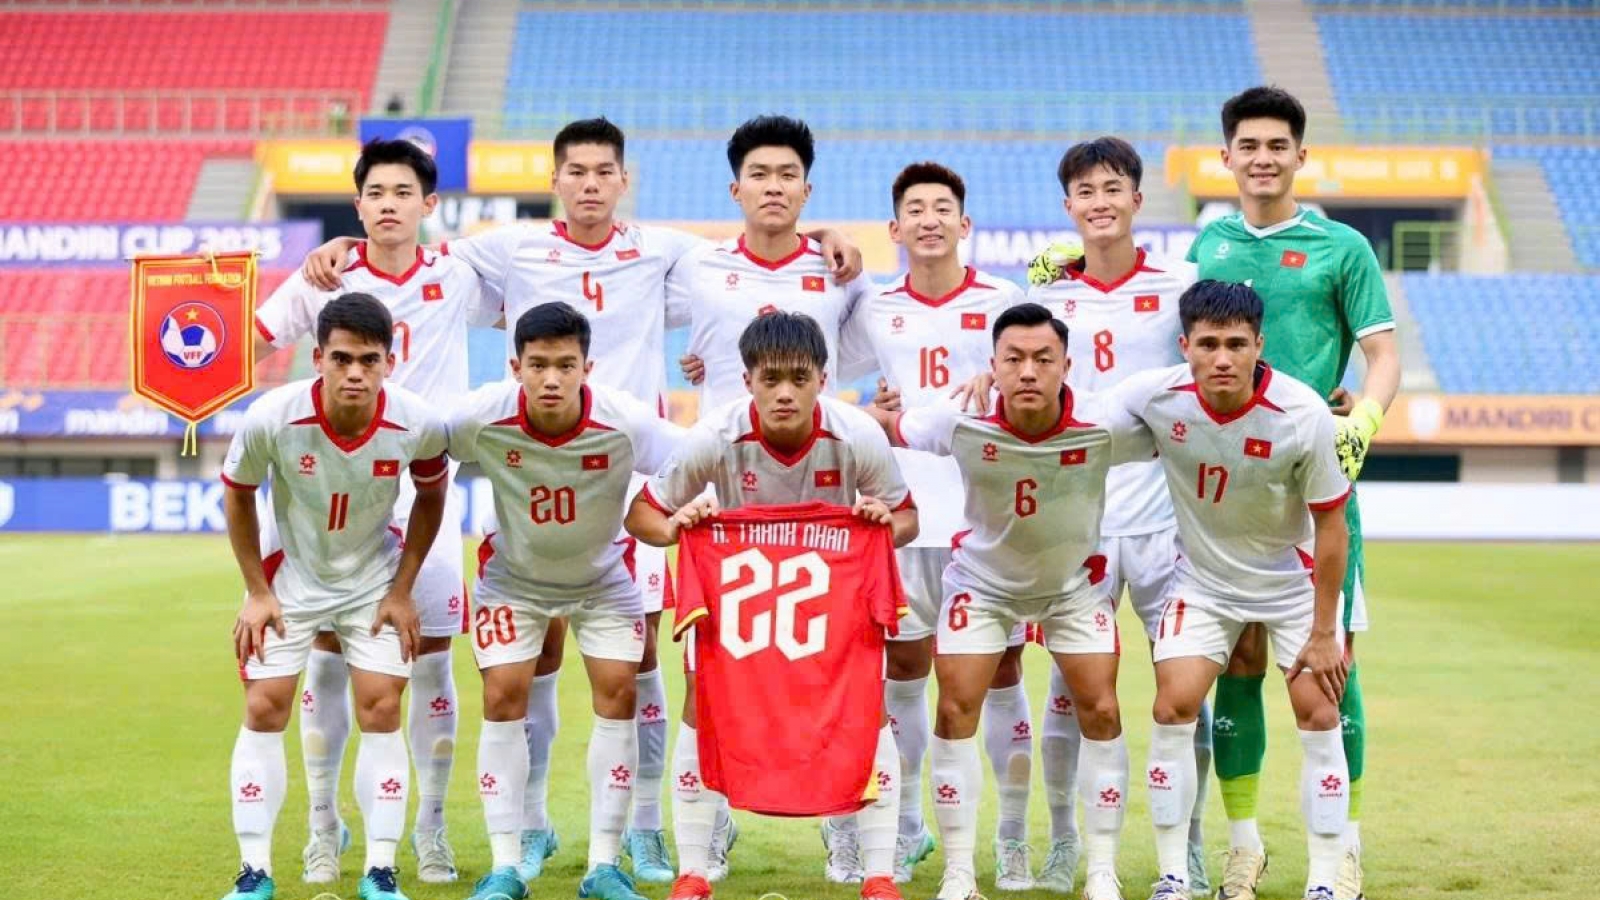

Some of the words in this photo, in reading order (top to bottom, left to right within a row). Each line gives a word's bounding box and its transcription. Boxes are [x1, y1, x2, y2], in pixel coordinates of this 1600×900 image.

[0, 225, 118, 260] ANDIRI
[582, 271, 603, 312] 4
[183, 350, 203, 361] VFF
[919, 346, 950, 389] 16
[1093, 330, 1115, 373] 8
[1446, 406, 1573, 431] MANDIRI
[1014, 478, 1038, 518] 6
[1197, 462, 1229, 504] 17
[328, 492, 351, 532] 11
[529, 485, 577, 525] 20
[802, 522, 851, 551] NHAN
[719, 547, 831, 662] 22
[948, 592, 972, 632] 6
[474, 605, 516, 651] 20
